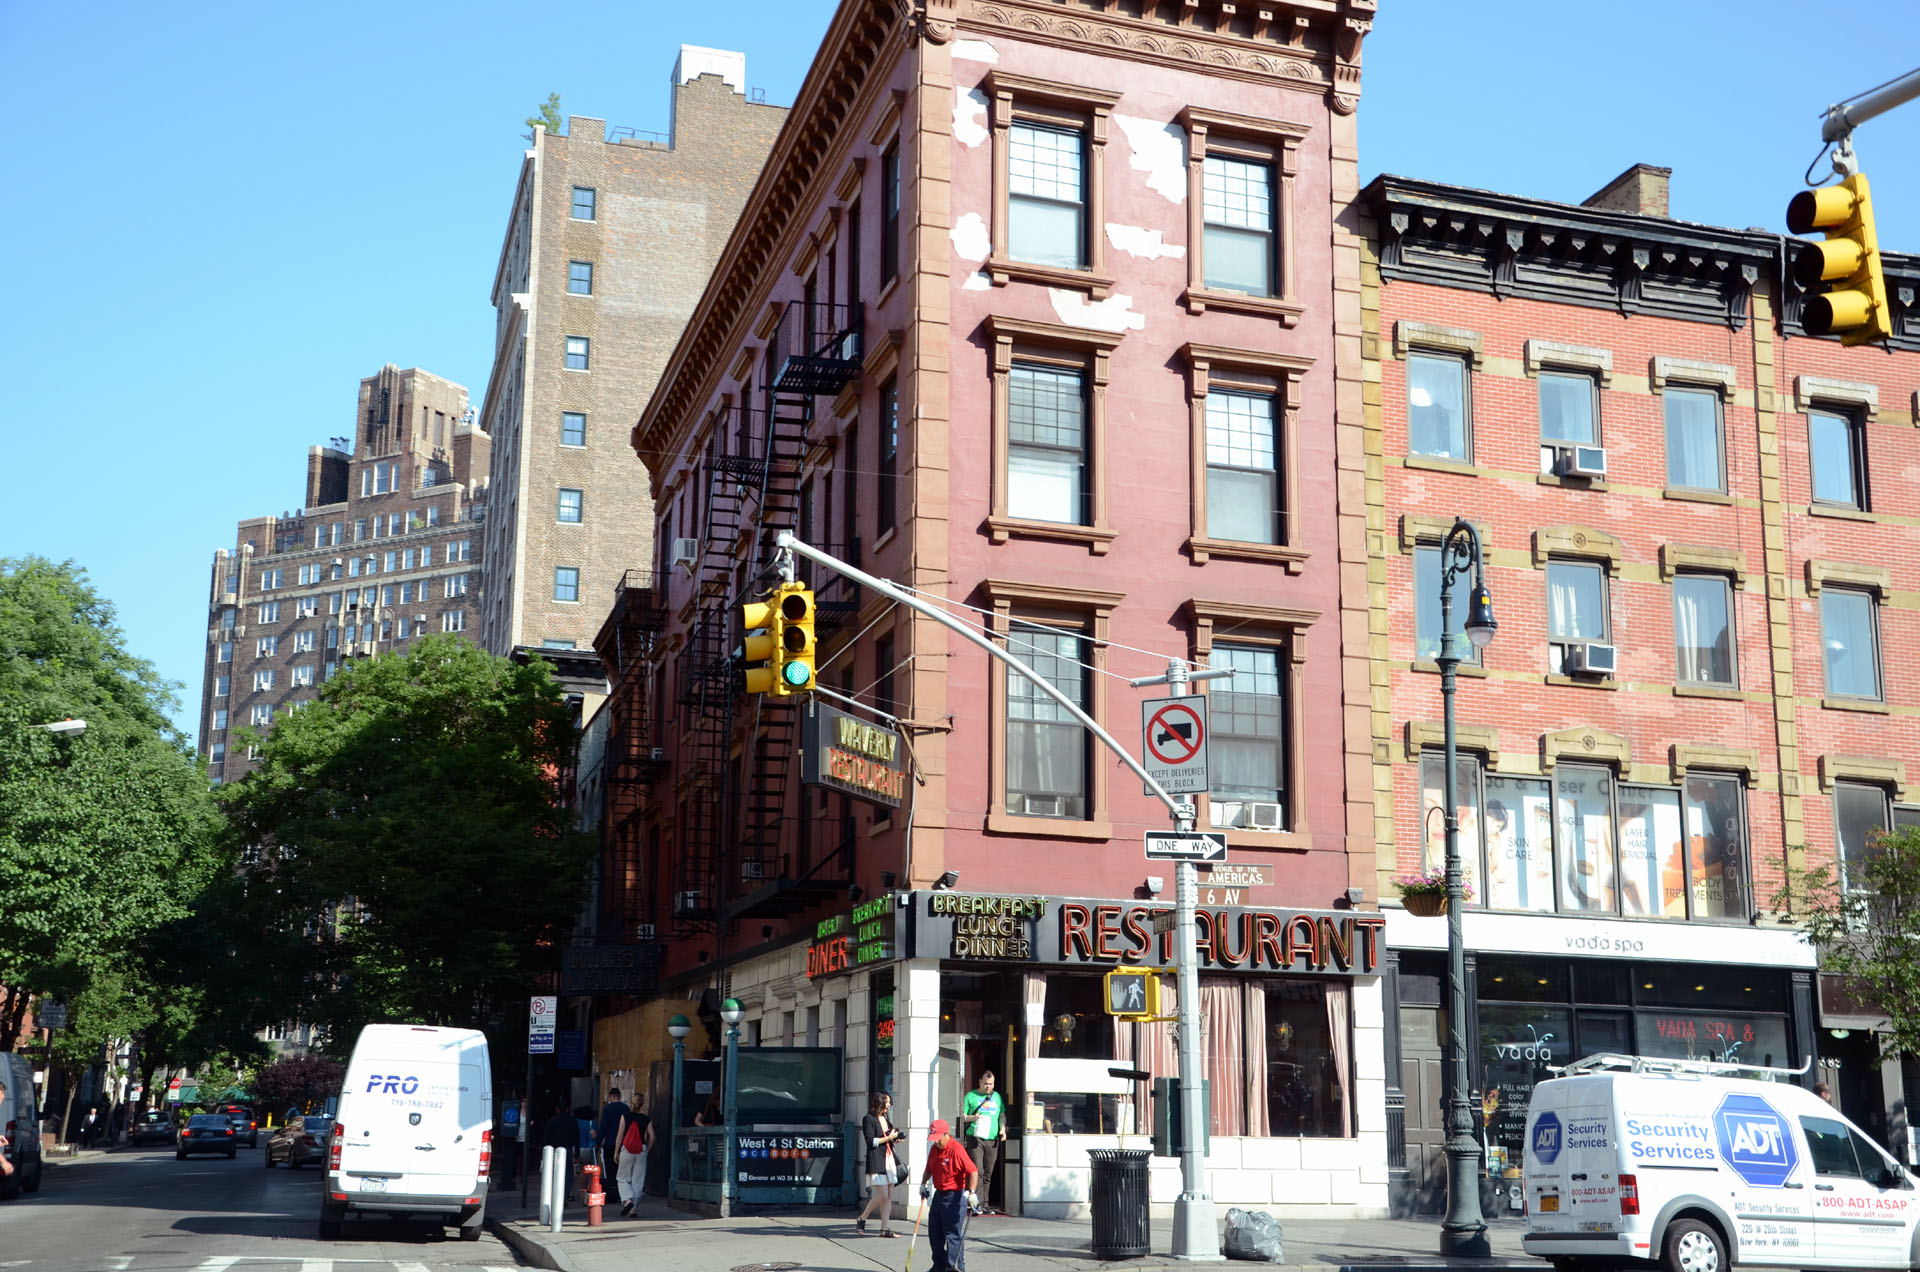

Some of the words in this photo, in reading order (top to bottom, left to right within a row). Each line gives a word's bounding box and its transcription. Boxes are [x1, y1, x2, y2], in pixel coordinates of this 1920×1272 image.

[839, 716, 897, 762] WAVERLY
[829, 747, 905, 799] RESTAURANT
[1147, 769, 1169, 778] EXCEPT
[1171, 767, 1205, 777] DELIVERIES
[1174, 779, 1195, 788] BLOCK
[1540, 780, 1586, 794] Lser
[1597, 779, 1654, 799] Cnter
[1540, 814, 1584, 826] PAKAGES
[1624, 829, 1649, 838] LASER
[1156, 840, 1178, 851] ONE
[1192, 841, 1214, 852] WAY
[1508, 838, 1530, 848] SKIN
[1627, 840, 1648, 849] HAIR
[1506, 850, 1533, 860] CARE
[1207, 873, 1264, 884] AMERICAS
[1693, 877, 1720, 888] BODY
[1206, 889, 1216, 904] 6
[1224, 889, 1240, 905] AV
[1665, 888, 1723, 901] TREMENTS
[852, 897, 888, 924] BREAKFAST
[933, 894, 1048, 916] BREAKFAST
[859, 920, 881, 942] LUNCH
[957, 915, 1025, 936] LUNCH
[1063, 903, 1386, 968] RESTAURANT
[955, 936, 1030, 958] DINNER
[1565, 935, 1609, 950] vada
[1614, 938, 1644, 953] spa
[807, 936, 848, 979] DINER
[858, 941, 882, 963] DINNER
[1657, 1019, 1697, 1038] VADA
[1706, 1022, 1735, 1041] SPA
[1744, 1024, 1754, 1042] &
[1496, 1044, 1552, 1061] vada
[366, 1074, 419, 1095] PRO
[1516, 1084, 1531, 1092] HAIR
[1504, 1122, 1526, 1130] MANIC
[1568, 1121, 1607, 1136] Security
[1627, 1119, 1709, 1142] Security
[739, 1138, 766, 1148] West
[769, 1138, 777, 1148] 4
[781, 1138, 793, 1148] St
[796, 1138, 834, 1149] Station
[1536, 1127, 1558, 1149] ADT
[1567, 1137, 1608, 1149] Services
[1733, 1122, 1781, 1157] ADT
[1630, 1141, 1715, 1160] Services
[1571, 1187, 1616, 1196] 800-ADT-ASAP
[1735, 1202, 1746, 1211] ADT
[1750, 1203, 1772, 1214] Security
[1775, 1204, 1800, 1214] Services
[1822, 1196, 1908, 1210] 800-ADT-ASAP
[1839, 1210, 1895, 1219] www.adt.com
[1741, 1224, 1753, 1234] 229
[1755, 1224, 1762, 1234] W
[1780, 1225, 1797, 1235] Street
[1739, 1237, 1753, 1246] New
[1771, 1238, 1780, 1247] NY
